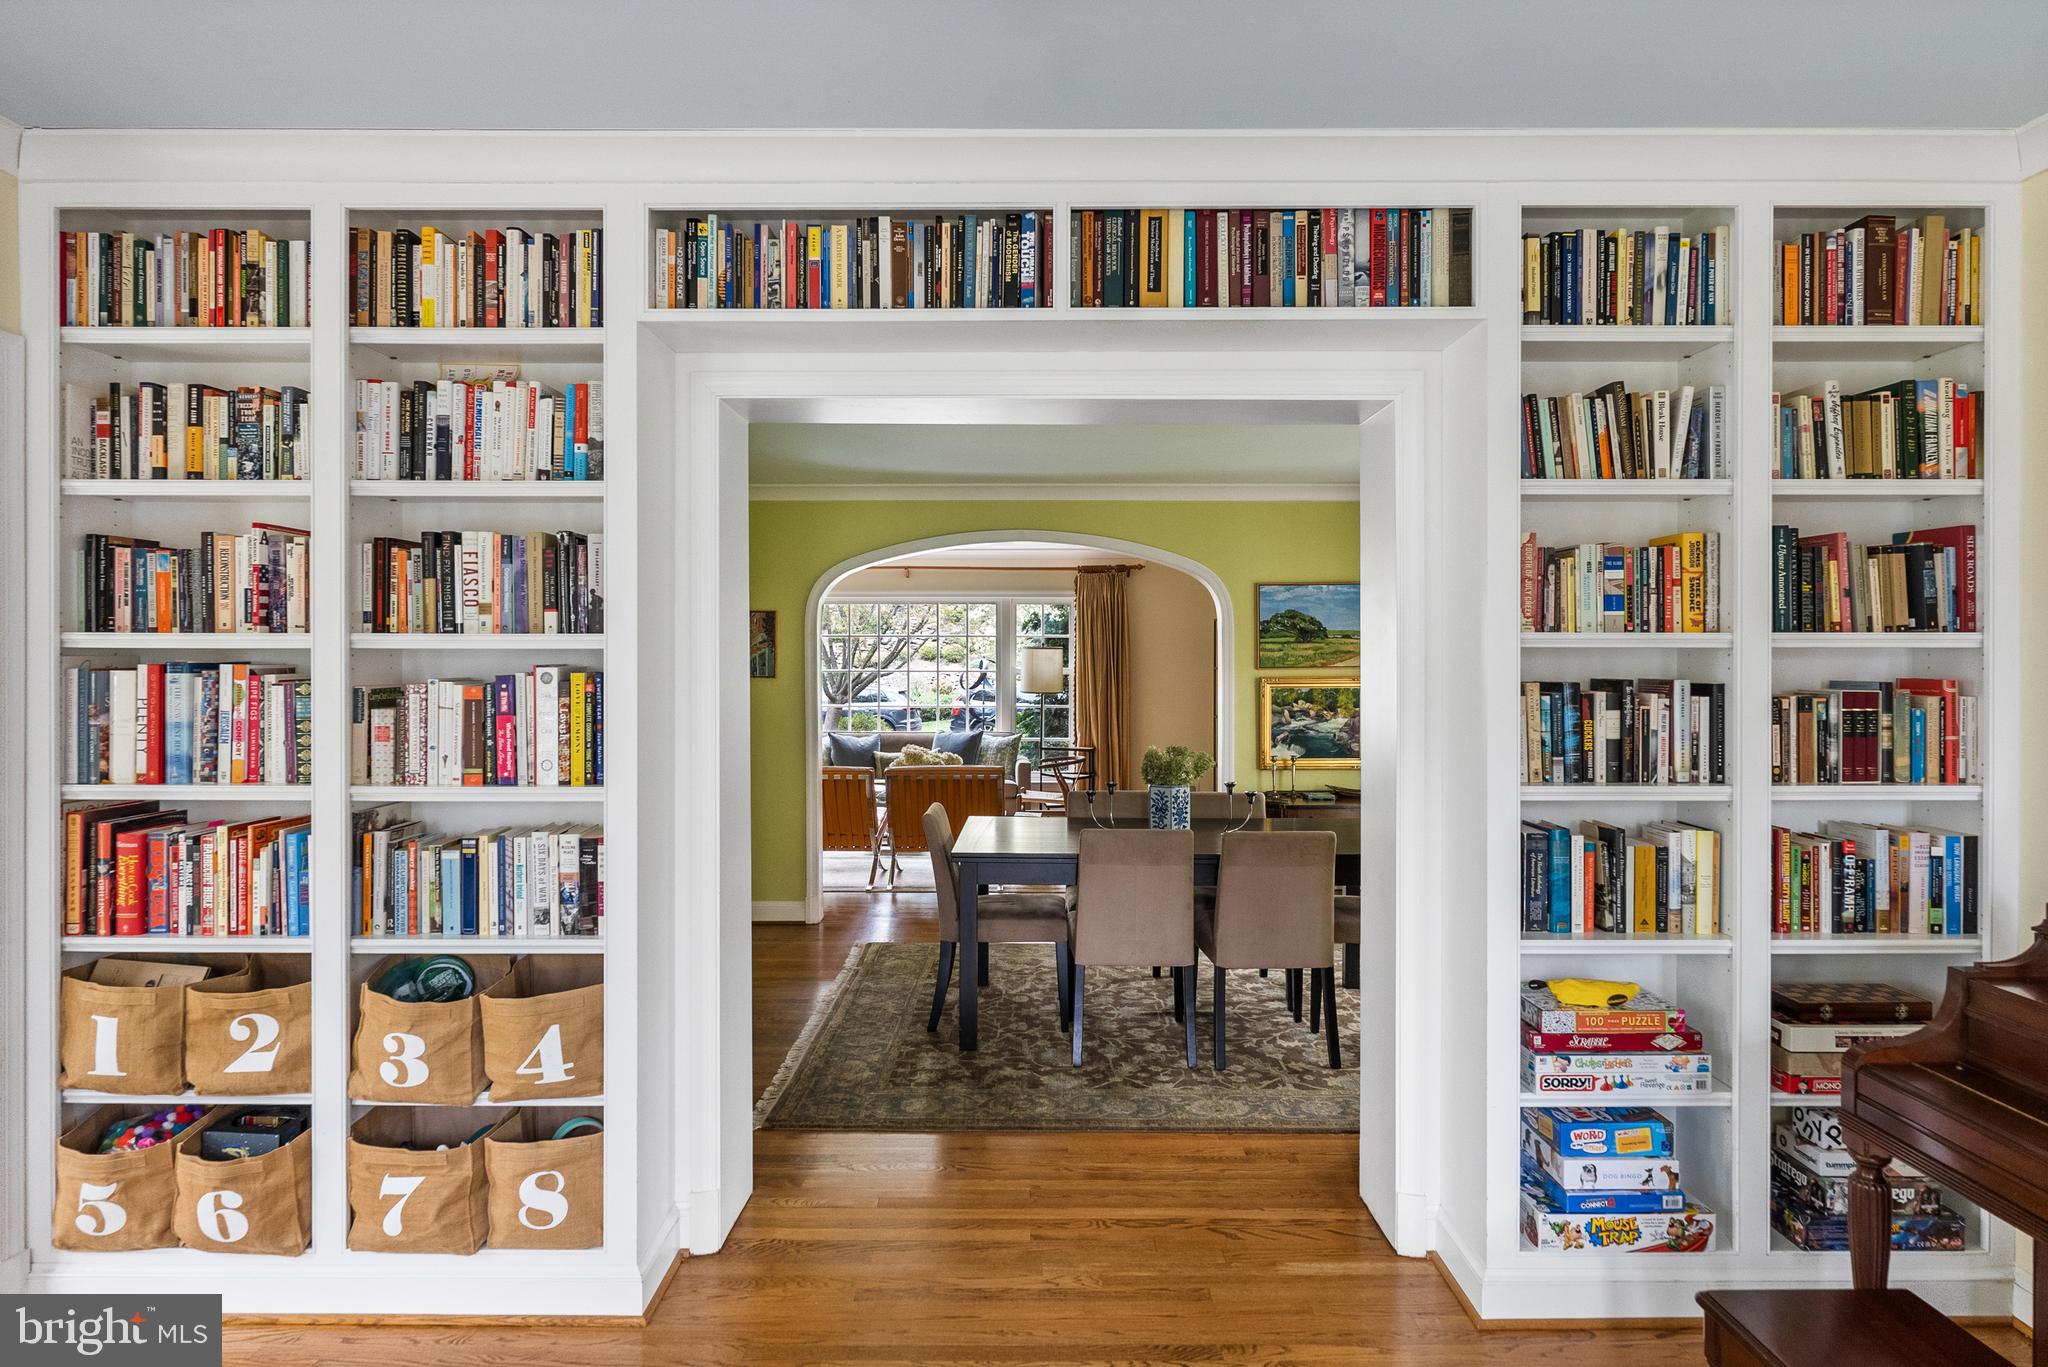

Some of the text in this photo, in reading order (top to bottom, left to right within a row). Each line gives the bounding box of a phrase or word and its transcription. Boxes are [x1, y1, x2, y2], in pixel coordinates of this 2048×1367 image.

[677, 247, 683, 257] NO
[1021, 231, 1029, 276] TOUCH
[1342, 227, 1350, 287] PSYCHOLOGY
[1374, 224, 1385, 290] MICROECONOMICS
[677, 275, 683, 283] OF
[1942, 380, 1952, 418] headlong
[475, 398, 483, 450] DEMOCRATIC
[1829, 400, 1842, 461] Jeffrey Eugenides
[1924, 389, 1938, 466] JONATHAN FRANZEN
[220, 548, 229, 600] RECONSTRUCTION
[1777, 544, 1786, 569] Ulysses
[463, 552, 479, 607] FIASCO
[1696, 601, 1700, 610] OF
[136, 698, 147, 754] PLENTY
[220, 710, 229, 744] JERUSALEM
[559, 709, 569, 740] Lavash
[1584, 720, 1592, 750] CLOCKERS
[128, 855, 138, 873] How
[538, 843, 546, 856] SIX
[538, 858, 546, 875] DAYS
[117, 855, 127, 906] Everything
[128, 884, 138, 905] Cook
[203, 844, 213, 908] BARBECUE! BIBLE
[516, 864, 524, 900] Northern Ireland
[538, 887, 546, 903] WAR
[1585, 1016, 1604, 1026] 100
[1621, 1016, 1660, 1026] PUZZLE
[86, 1014, 127, 1077] 1
[223, 1014, 281, 1073] 2
[379, 1032, 430, 1088] 3
[515, 1024, 576, 1084] 4
[1543, 1077, 1592, 1090] SORRY!
[1816, 1082, 1841, 1090] MONO
[1573, 1130, 1604, 1141] WORD
[75, 1182, 127, 1236] 5
[196, 1190, 249, 1243] 6
[378, 1172, 426, 1237] 7
[518, 1170, 569, 1230] 8
[1580, 1200, 1608, 1209] CONNECT
[1592, 1216, 1638, 1233] MOUSE
[1598, 1230, 1638, 1248] TRAP
